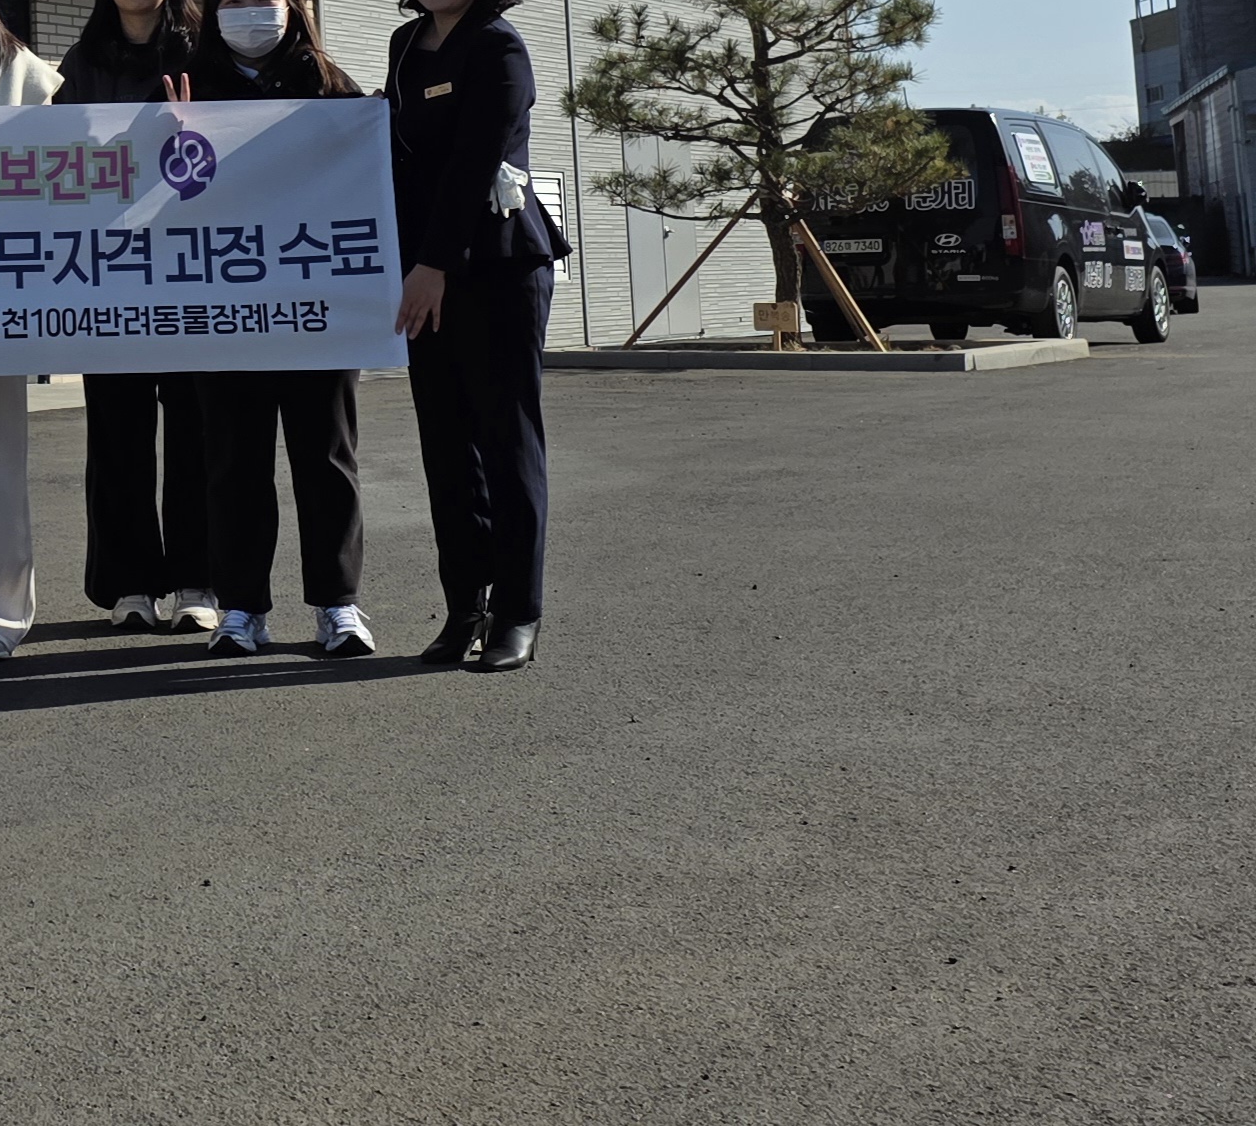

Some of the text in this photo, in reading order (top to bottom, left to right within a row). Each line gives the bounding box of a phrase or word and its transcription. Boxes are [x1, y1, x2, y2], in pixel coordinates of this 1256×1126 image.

[165, 224, 267, 284] 과정
[278, 217, 385, 280] 수료
[854, 240, 881, 252] 7340
